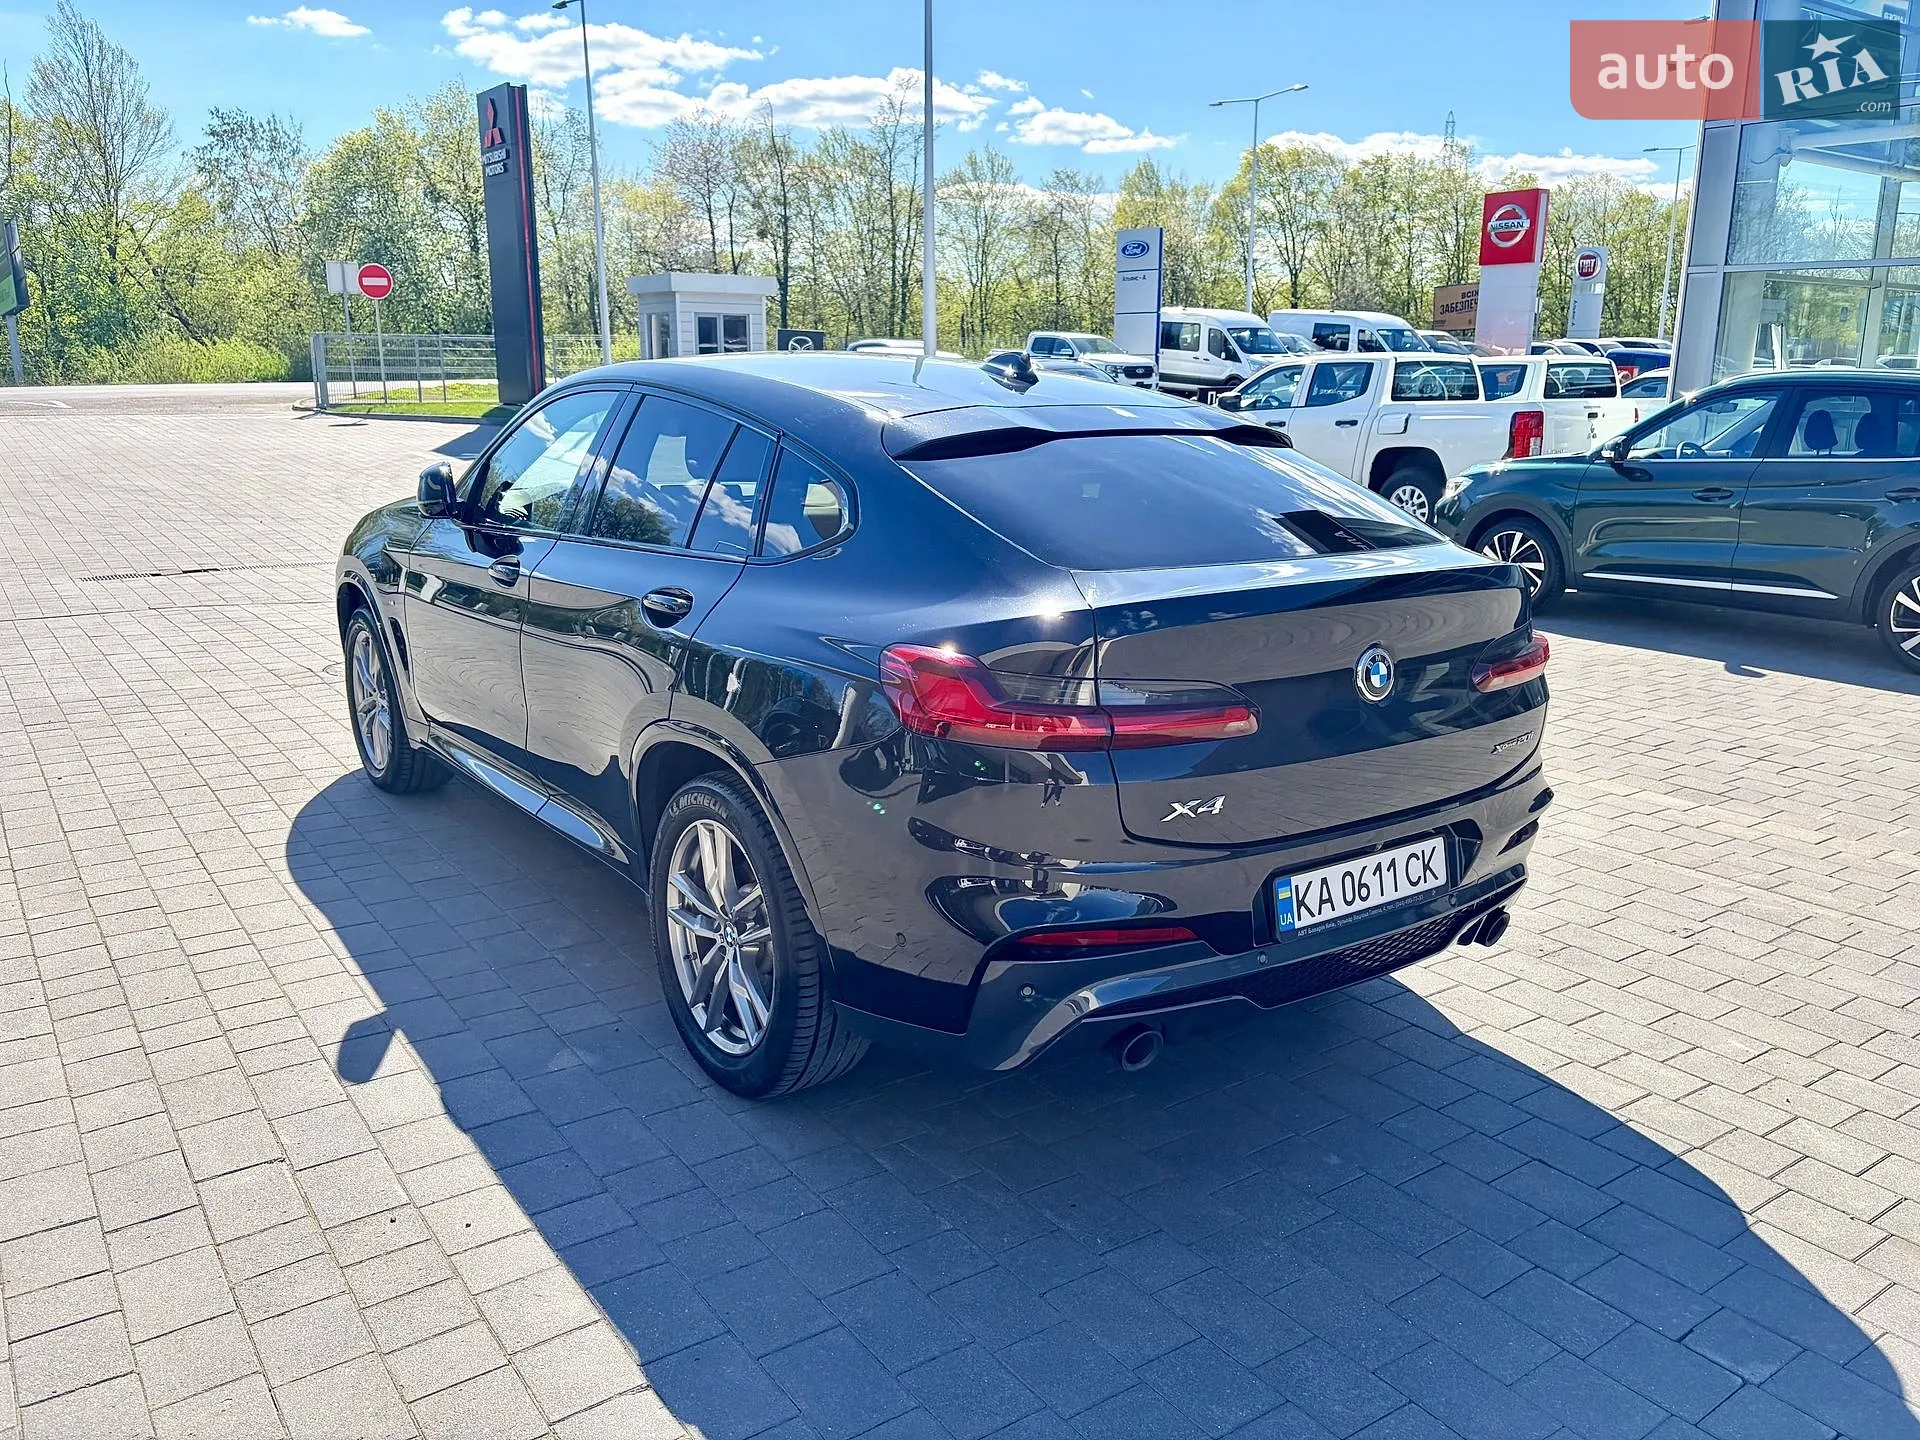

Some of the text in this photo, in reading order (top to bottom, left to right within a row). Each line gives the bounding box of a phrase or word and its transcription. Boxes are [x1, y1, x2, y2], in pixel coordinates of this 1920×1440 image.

[1490, 221, 1525, 231] NISSAN
[1124, 243, 1142, 255] Ford
[1580, 258, 1596, 273] FIAT
[1366, 653, 1390, 669] BMW
[679, 792, 729, 819] MICHELIN
[1160, 795, 1226, 822] X4
[1294, 846, 1439, 922] KA 0611 CK
[1279, 914, 1294, 926] UA
